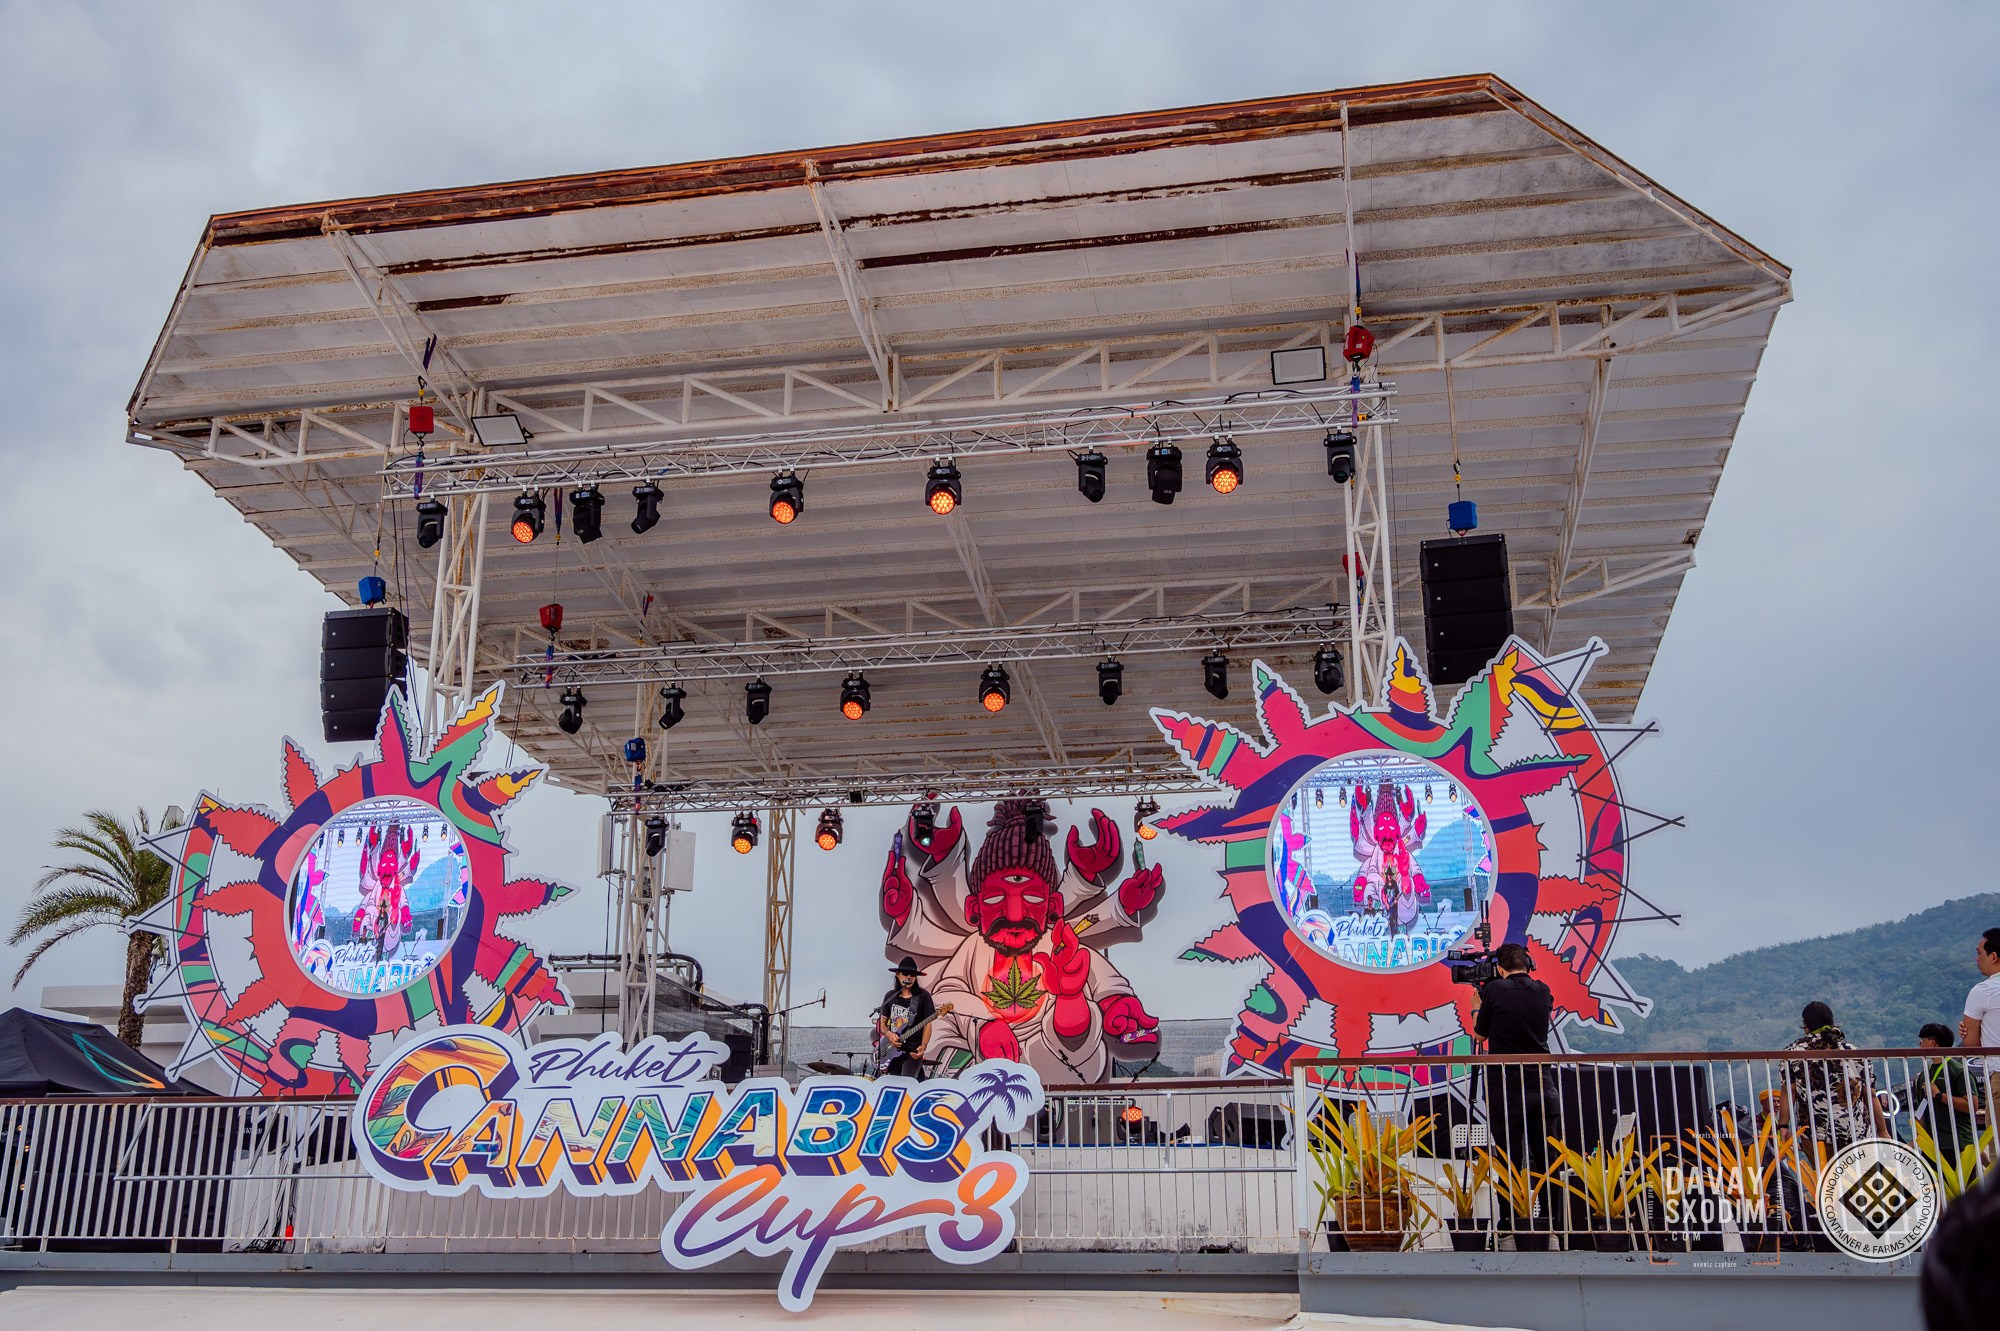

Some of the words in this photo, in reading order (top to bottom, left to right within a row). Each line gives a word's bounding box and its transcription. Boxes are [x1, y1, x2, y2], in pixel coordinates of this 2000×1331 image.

[1336, 917, 1387, 936] Phuket
[335, 945, 374, 964] Phuket
[530, 1039, 717, 1084] Phuket
[364, 1034, 978, 1187] CANNABIS
[673, 1164, 954, 1299] Cup
[937, 1161, 1018, 1252] 8
